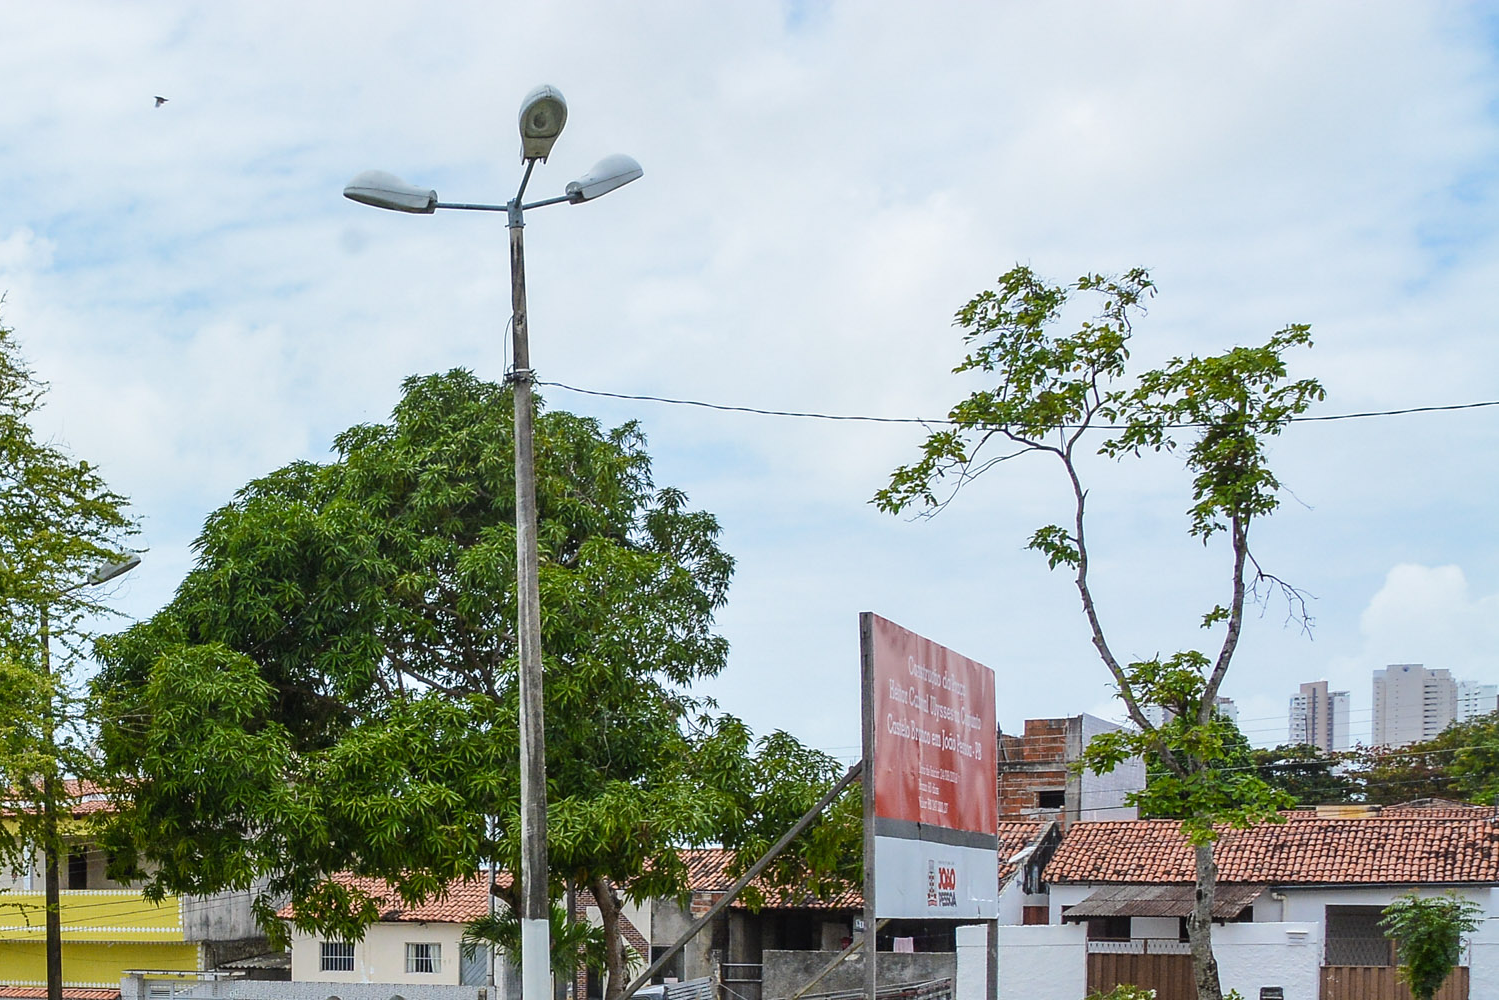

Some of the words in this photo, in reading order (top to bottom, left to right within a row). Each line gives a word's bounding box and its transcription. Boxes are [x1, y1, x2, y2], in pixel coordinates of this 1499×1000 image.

[930, 695, 953, 722] Ulysses
[887, 713, 910, 739] Castelo
[932, 732, 941, 748] em
[942, 729, 956, 751] João
[975, 741, 982, 760] PB
[938, 892, 957, 907] PESSOA
